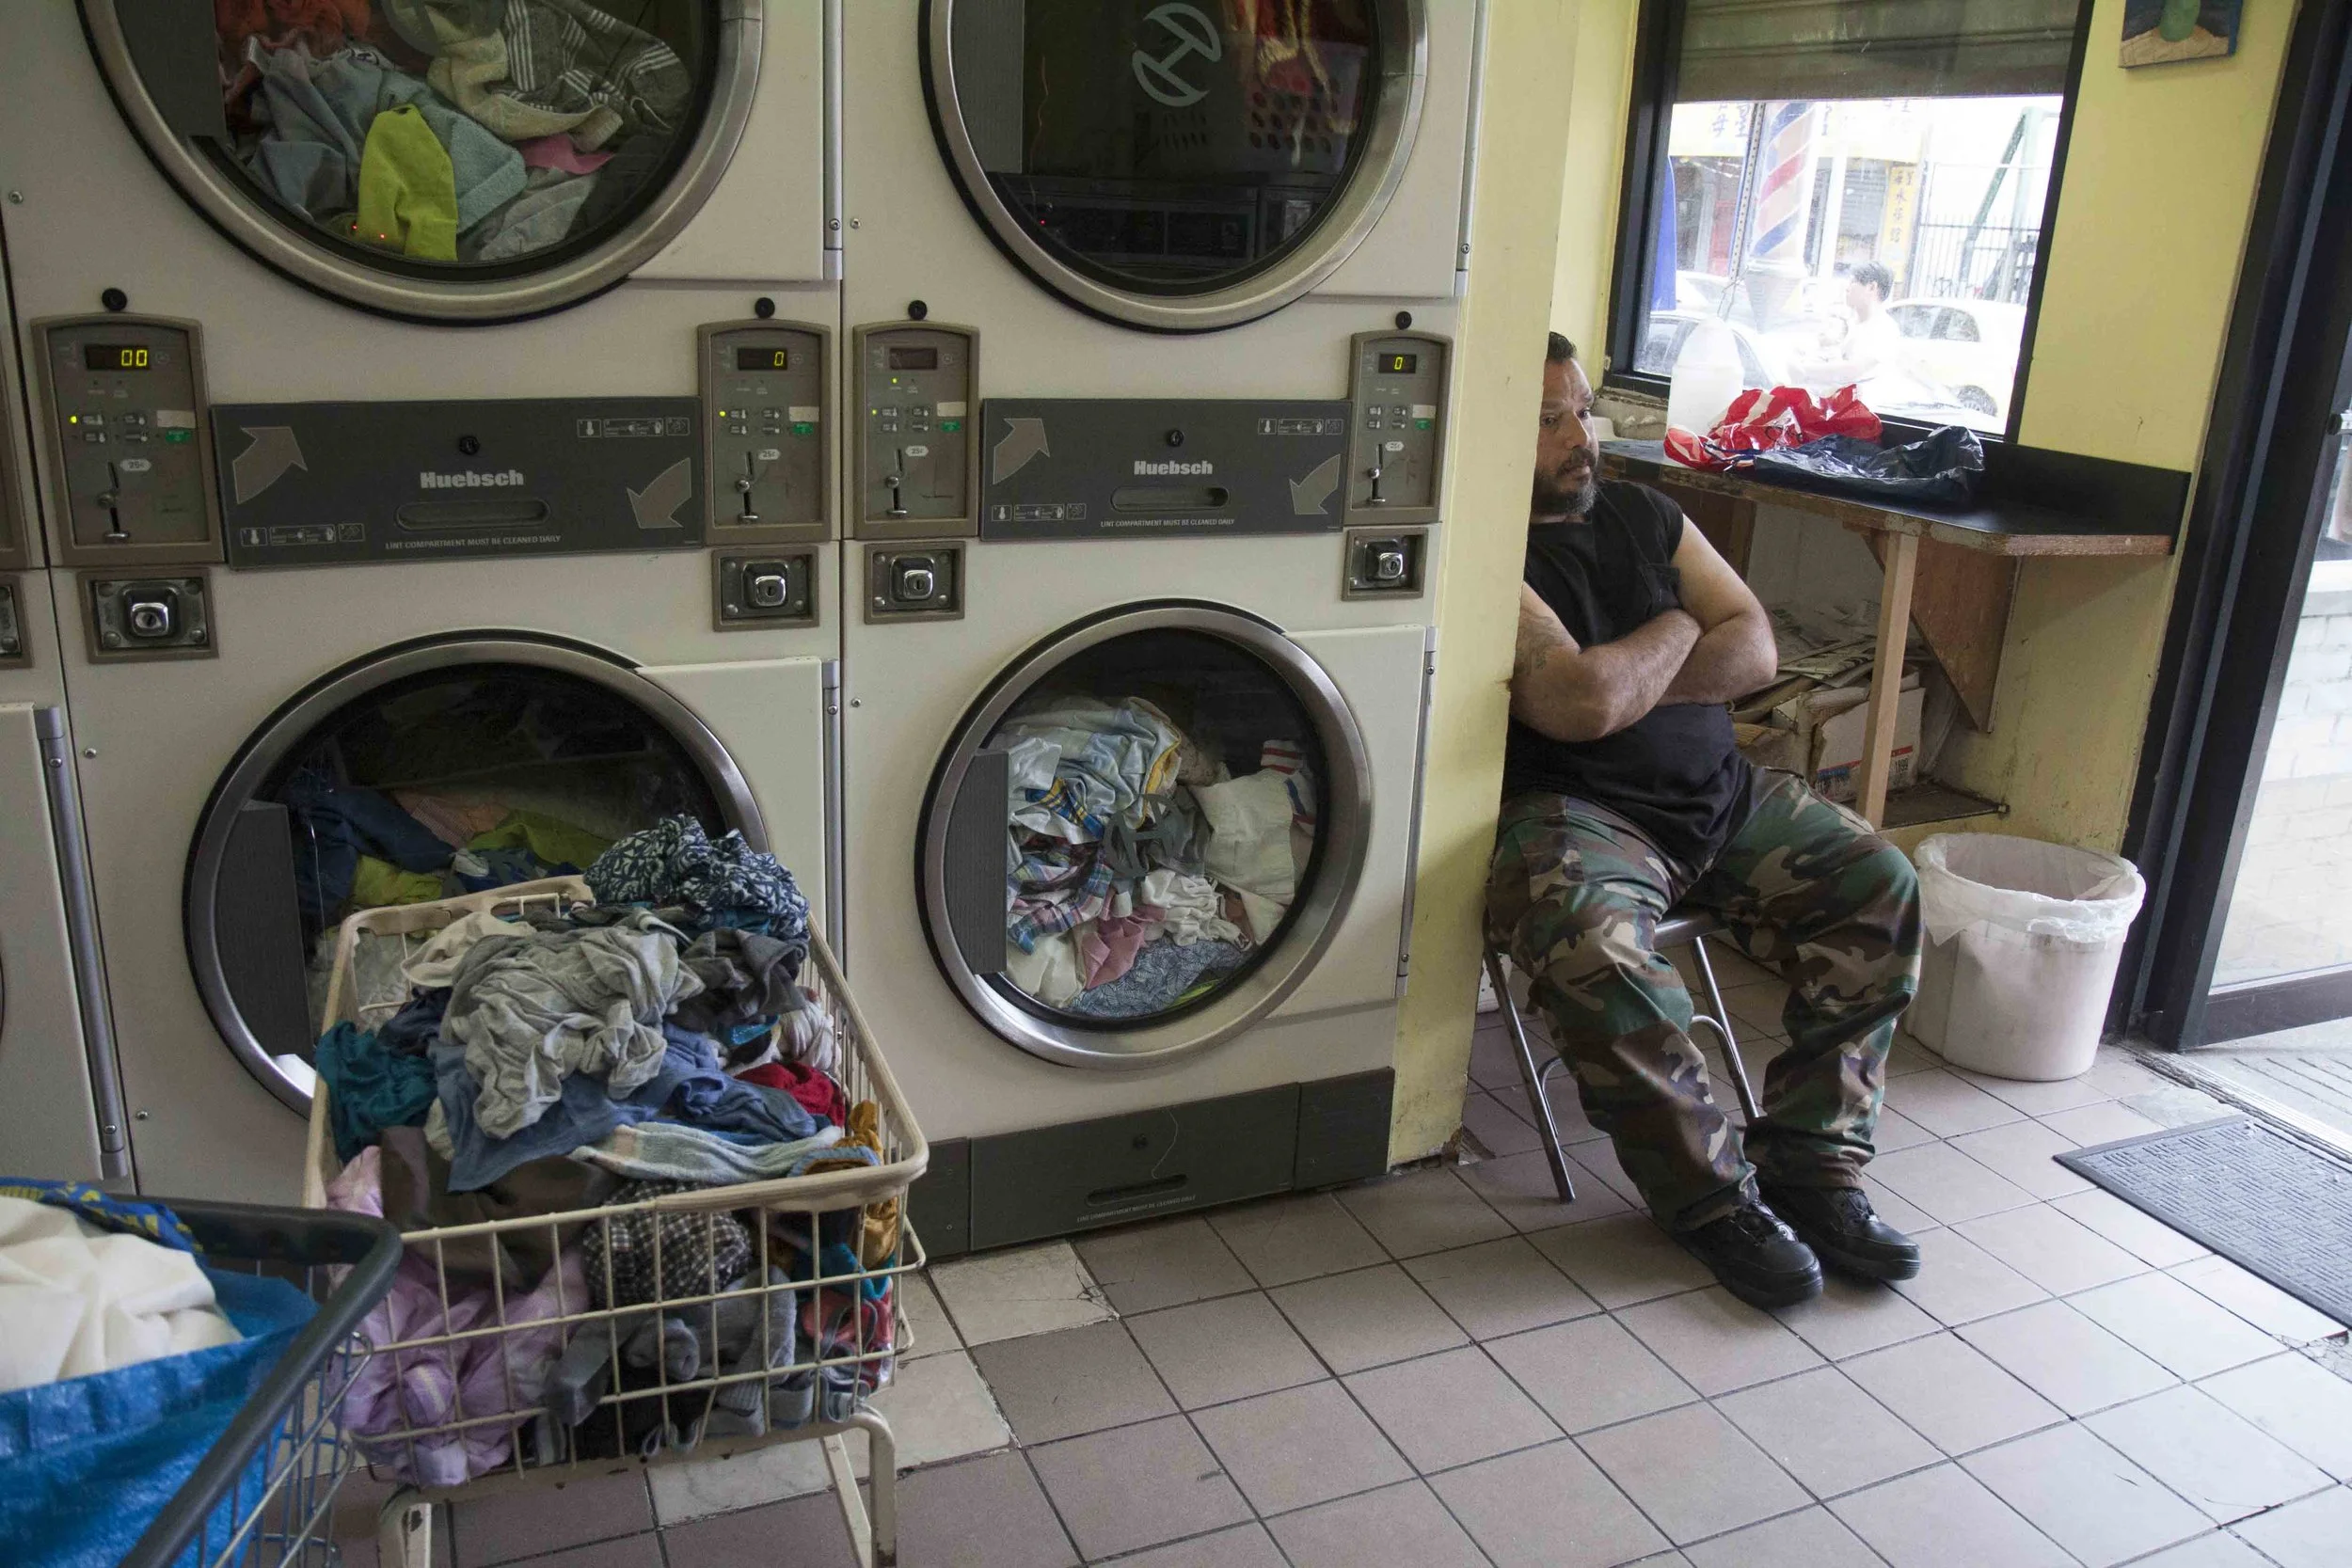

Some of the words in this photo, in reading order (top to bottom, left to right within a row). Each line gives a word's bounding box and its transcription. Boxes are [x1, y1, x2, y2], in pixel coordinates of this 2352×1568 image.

[1134, 460, 1213, 476] Huebsch
[420, 469, 524, 490] Huebsch
[1115, 519, 1162, 528] COMPARTMENT
[1163, 518, 1182, 527] MUST
[386, 542, 404, 550] LINT
[405, 539, 467, 549] COMPARTMENT
[468, 537, 490, 546] MUST
[502, 536, 539, 546] CLEANED
